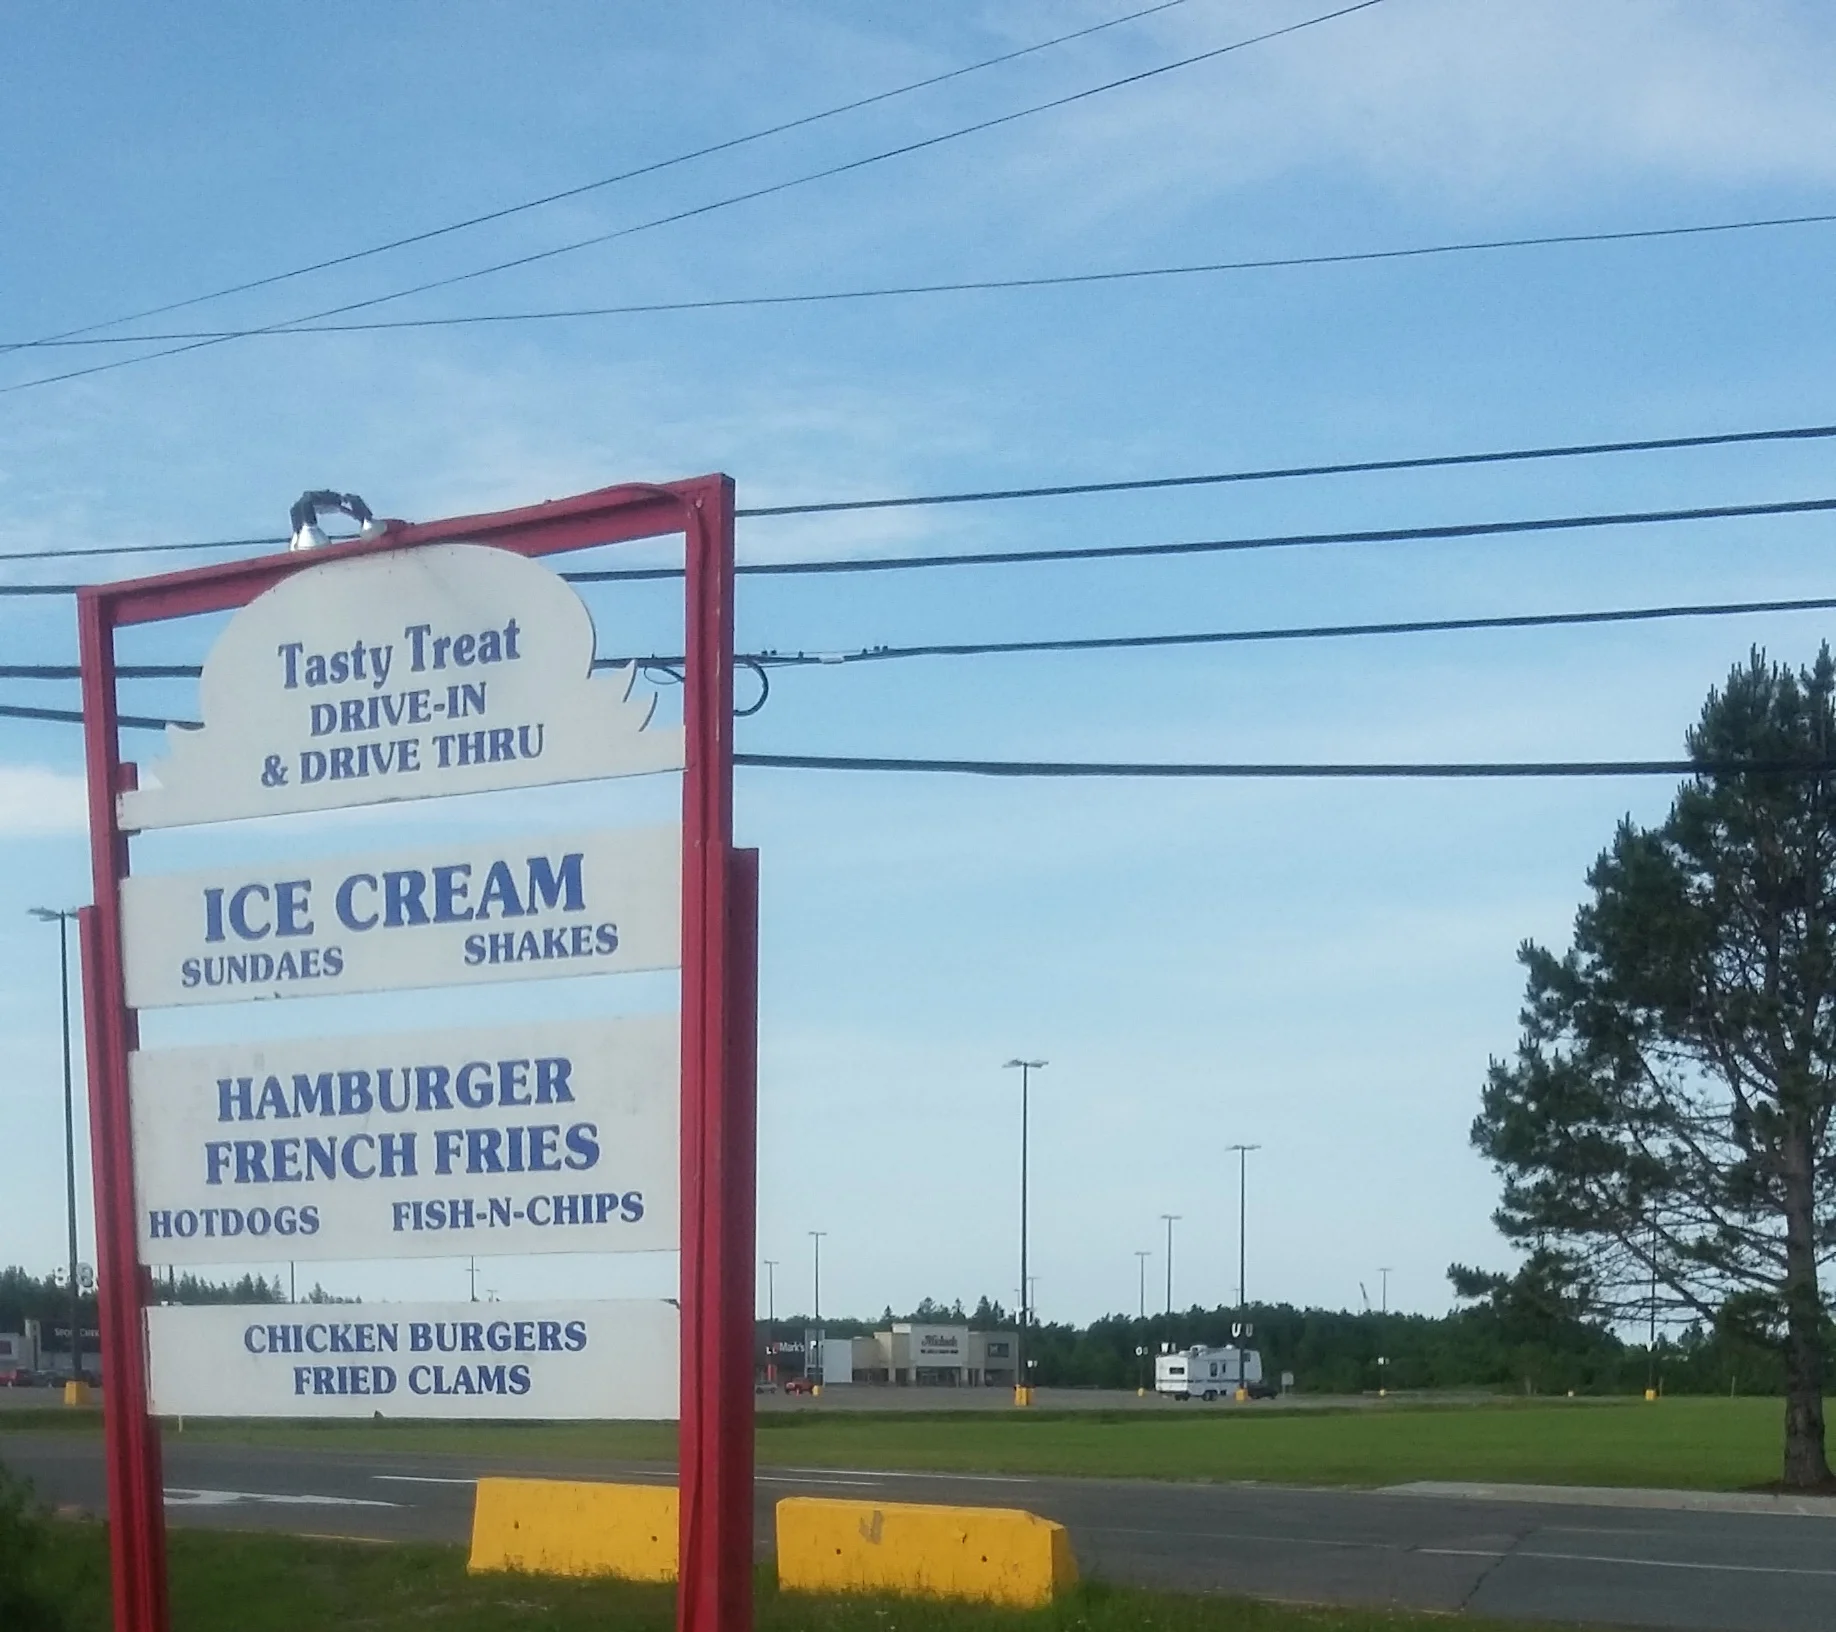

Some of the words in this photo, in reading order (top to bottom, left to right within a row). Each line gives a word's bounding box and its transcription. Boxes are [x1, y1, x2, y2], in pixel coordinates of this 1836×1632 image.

[278, 640, 393, 689] Tasty
[405, 618, 520, 672] Treat
[309, 681, 488, 737] DRIVE-IN
[261, 755, 288, 787] &
[300, 739, 420, 784] DRIVE
[432, 724, 543, 767] THRU
[204, 880, 314, 943] ICE
[335, 852, 587, 932] CREAM
[182, 947, 343, 987] SUNDAES
[465, 924, 618, 965] SHAKES
[217, 1058, 575, 1122] HAMBURGER
[205, 1133, 418, 1184] FRENCH
[434, 1123, 599, 1175] FRIES
[149, 1206, 319, 1238] HOTDOGS
[392, 1192, 643, 1231] FISH-N-CHIPS
[245, 1323, 398, 1353] CHICKEN
[409, 1321, 586, 1351] BURGERS
[294, 1366, 396, 1395] FRIED
[409, 1365, 530, 1395] CLAMS
